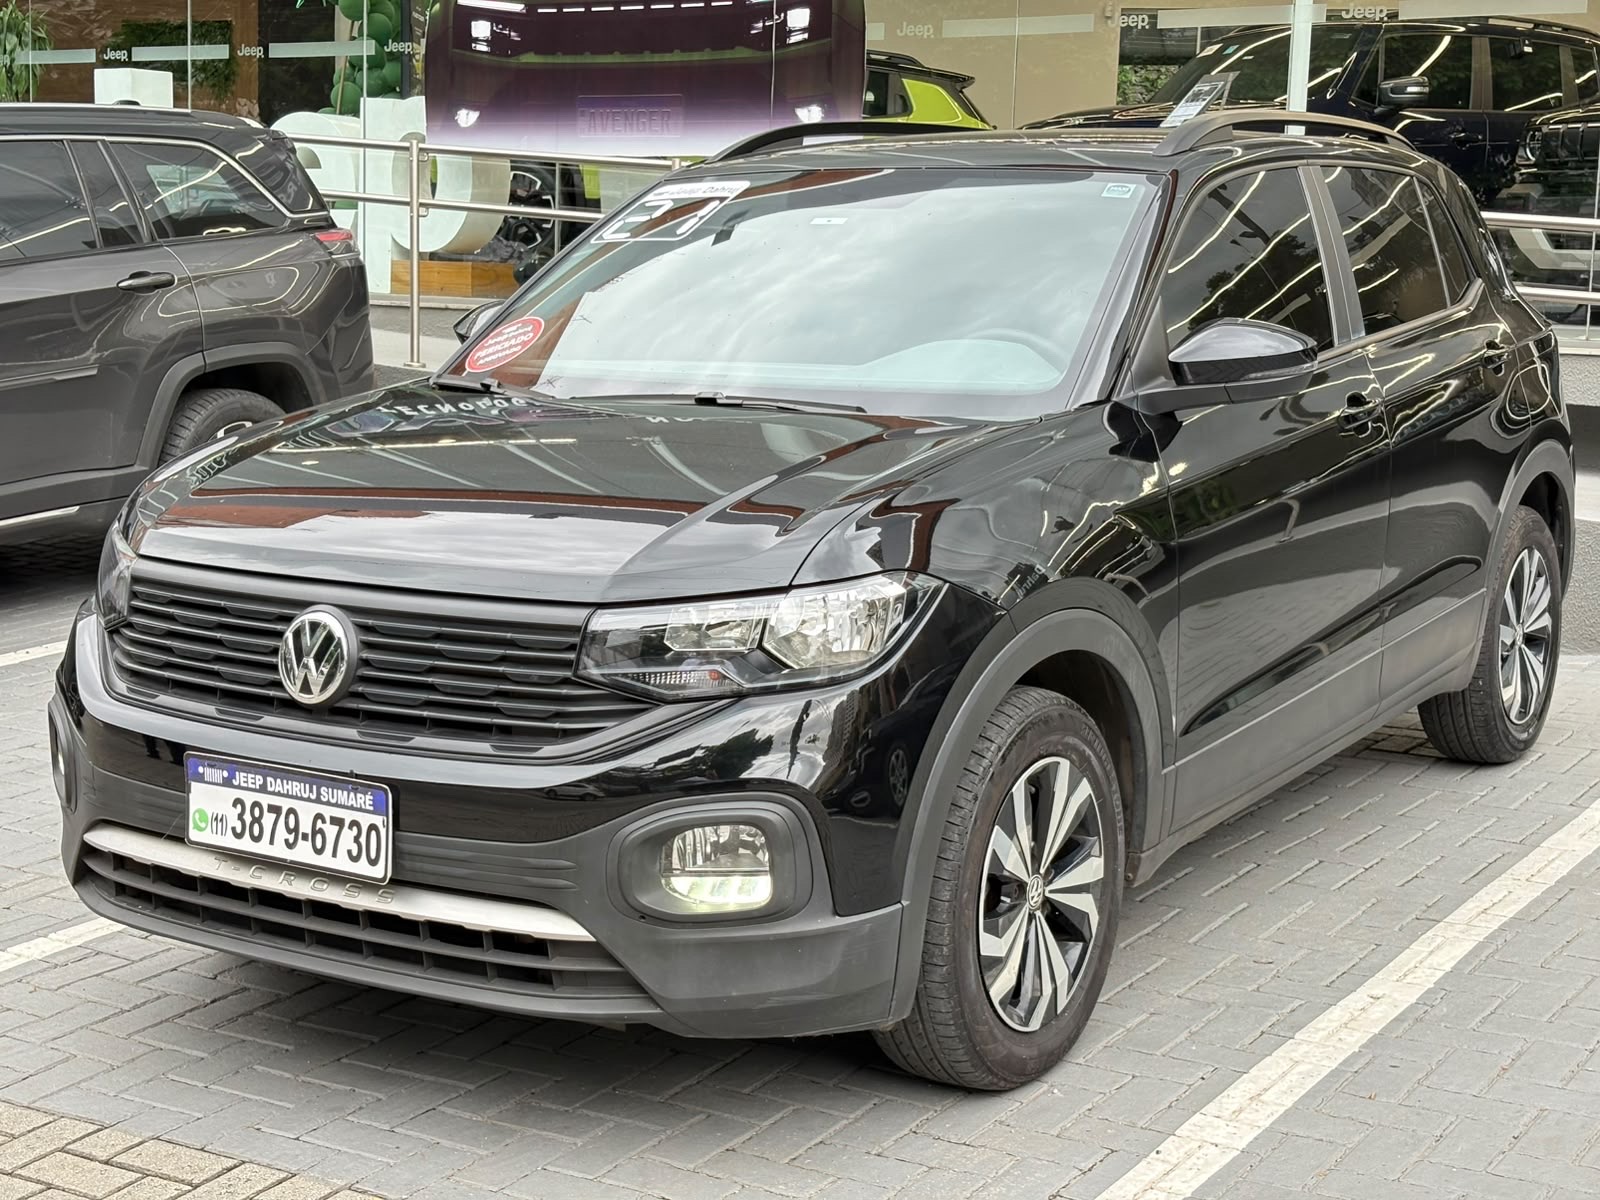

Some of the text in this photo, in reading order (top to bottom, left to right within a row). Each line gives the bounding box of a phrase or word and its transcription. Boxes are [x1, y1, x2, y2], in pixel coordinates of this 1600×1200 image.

[1342, 3, 1388, 20] Jeep
[1107, 12, 1149, 29] Jeep
[897, 21, 934, 38] Jeep
[104, 48, 128, 61] Jeep
[237, 44, 264, 58] Jeep
[384, 39, 413, 54] Jeep
[588, 109, 672, 133] AVENGER
[232, 771, 374, 811] JEEP DAHRUJ SUMARÉ
[210, 797, 382, 867] (11) 3879-6730
[214, 856, 395, 904] T-CROSS
